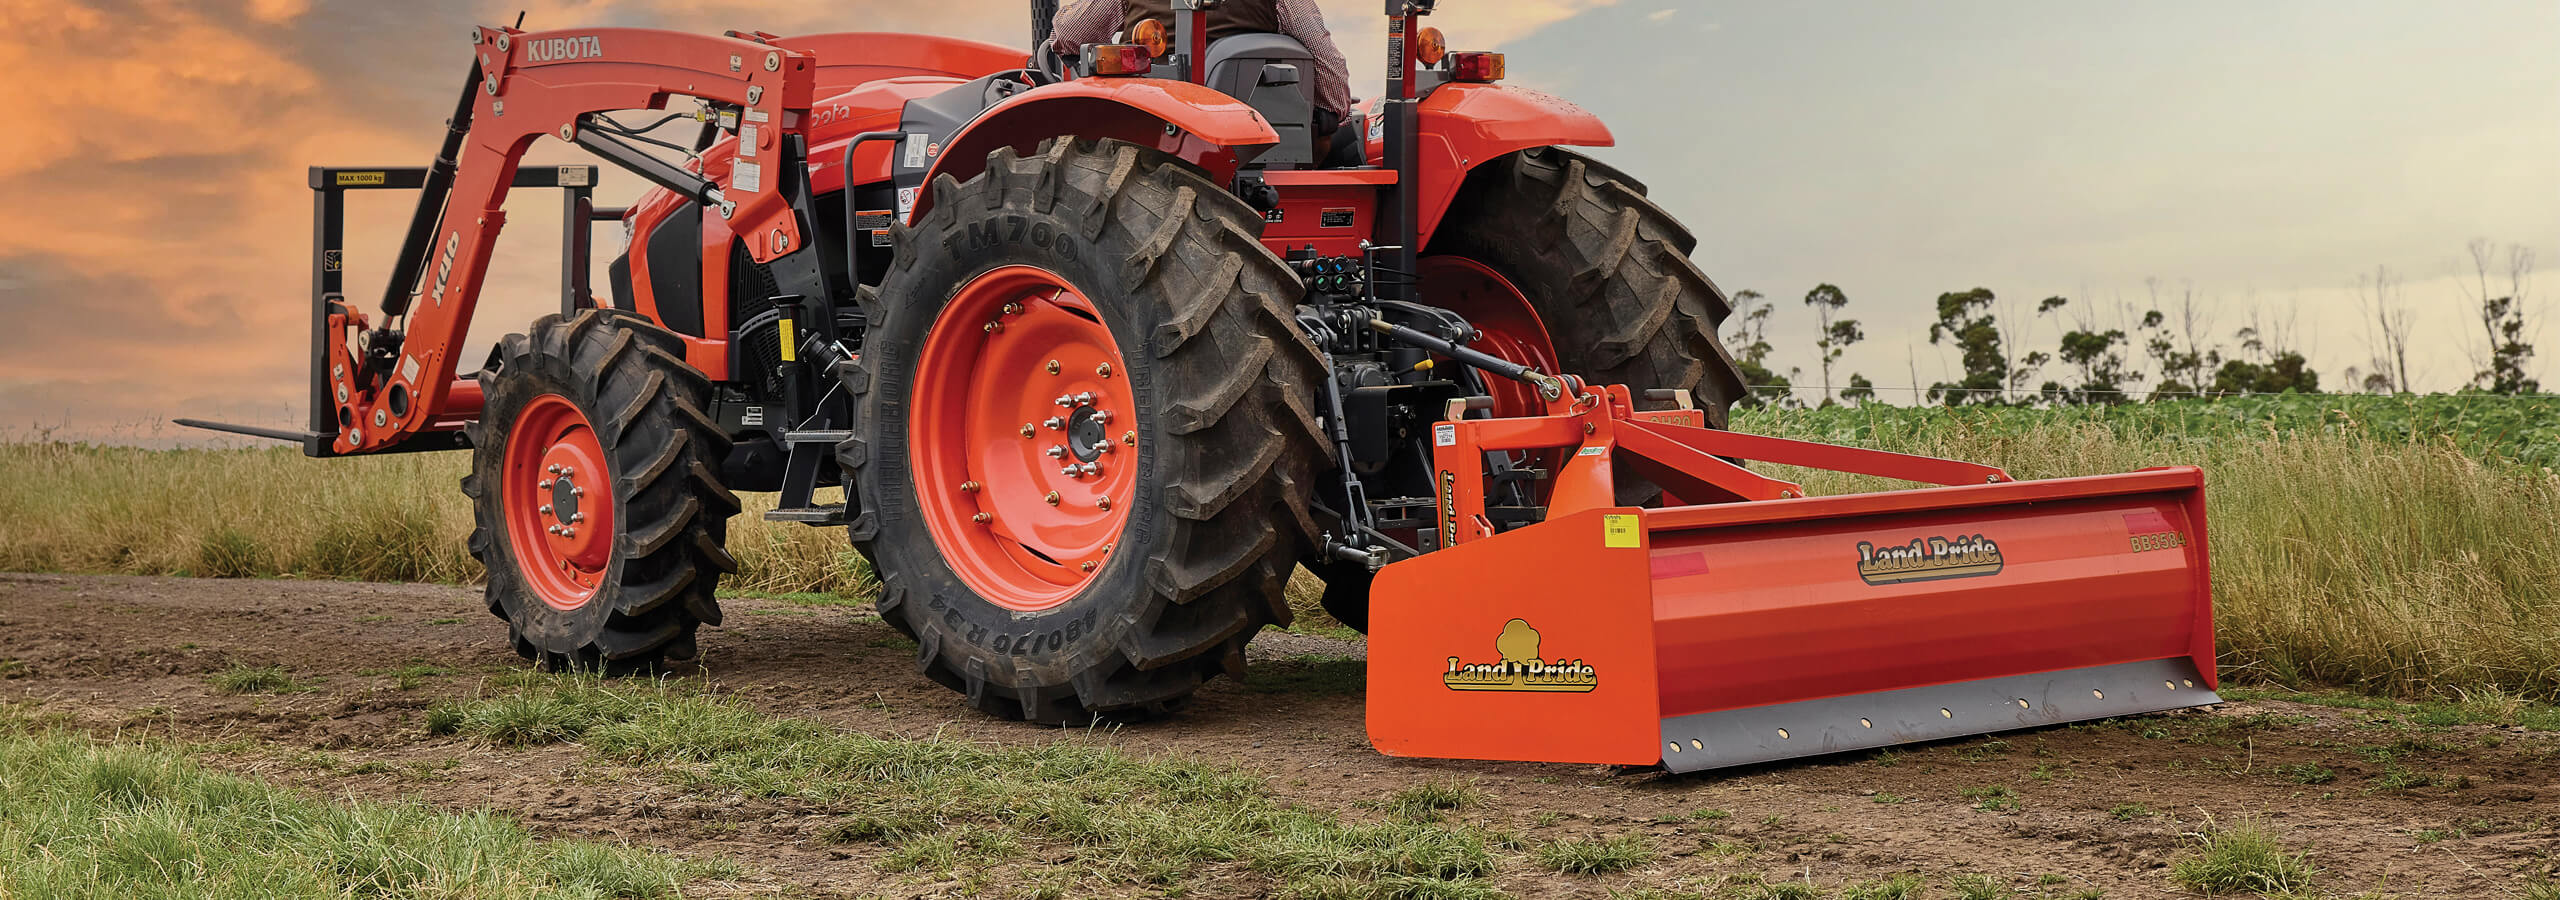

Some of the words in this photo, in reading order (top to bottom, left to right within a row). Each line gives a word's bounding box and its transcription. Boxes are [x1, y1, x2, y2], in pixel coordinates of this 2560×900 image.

[527, 35, 602, 62] KUBOTA
[811, 103, 850, 128] bota
[357, 174, 373, 182] 1000
[942, 215, 1077, 262] TM700
[1446, 472, 1456, 517] Land
[1859, 540, 1925, 572] Land
[1929, 536, 1998, 567] Pride
[2129, 531, 2187, 553] BB3584
[1446, 656, 1509, 682] Land
[1526, 658, 1595, 683] Pride
